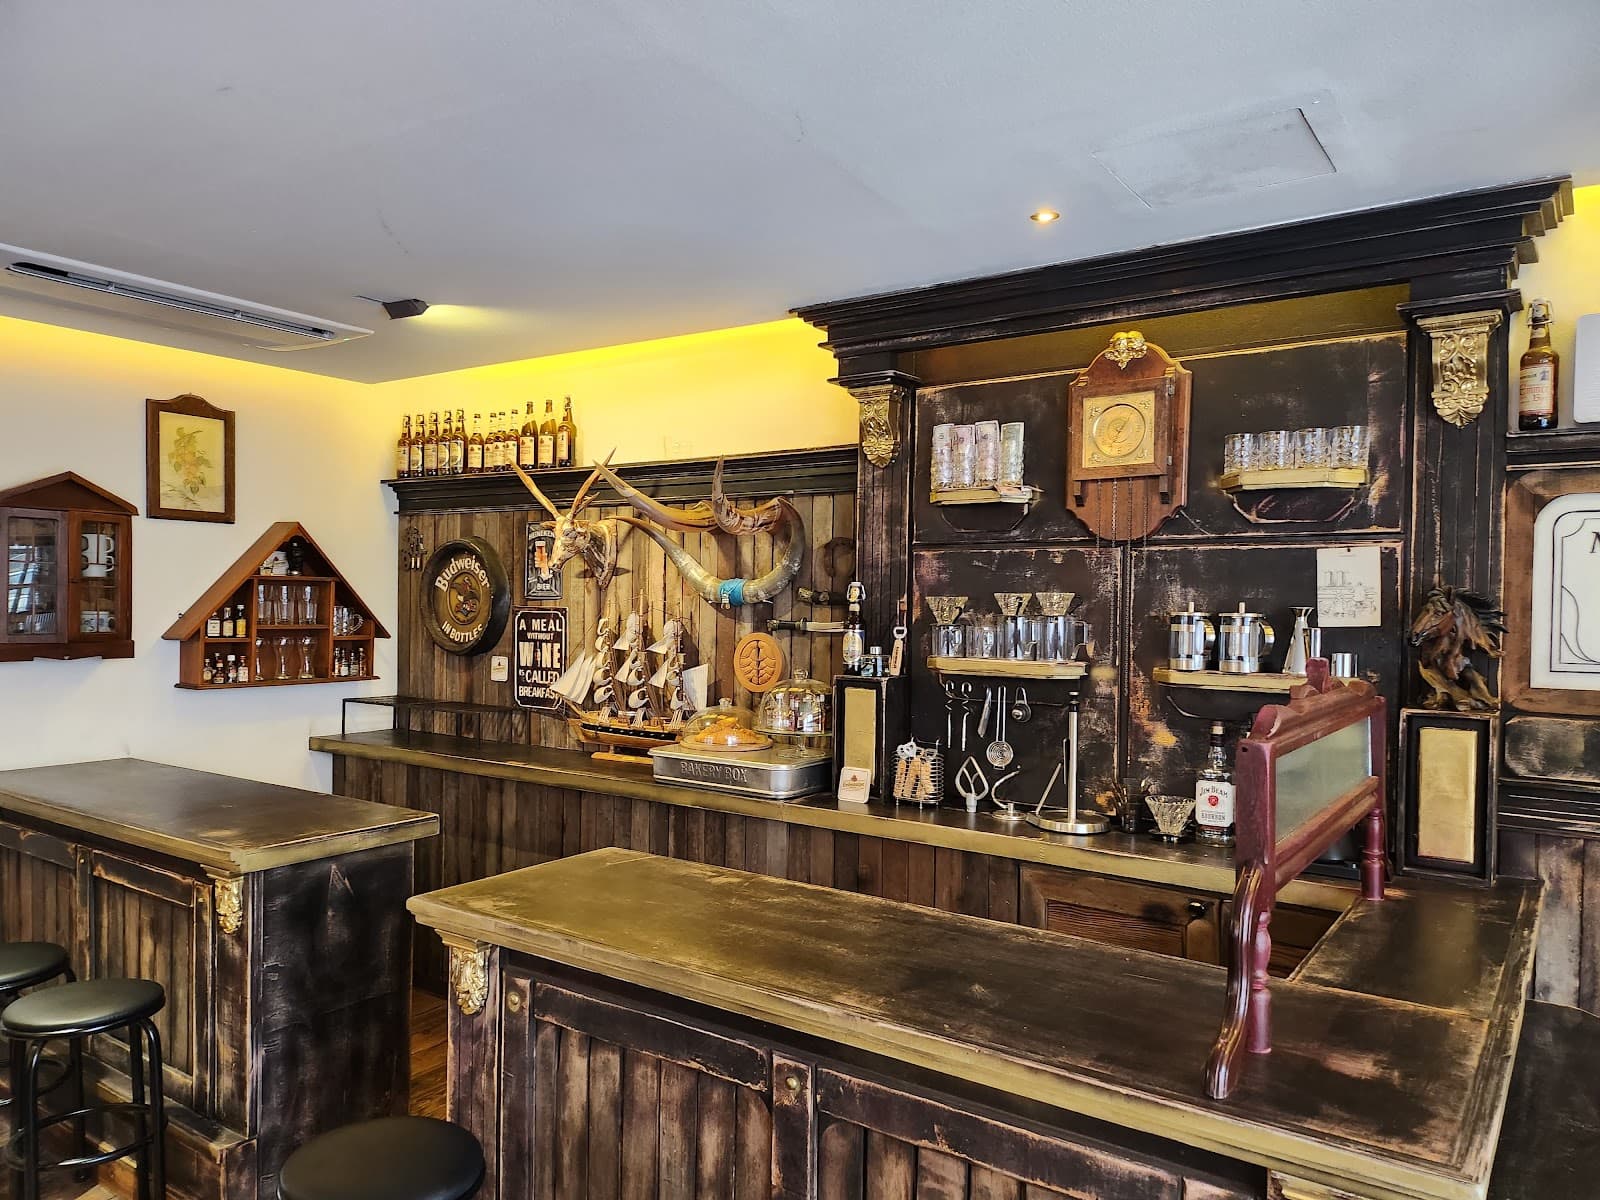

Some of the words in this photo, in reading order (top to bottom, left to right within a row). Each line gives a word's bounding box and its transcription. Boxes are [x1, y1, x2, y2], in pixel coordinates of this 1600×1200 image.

[435, 555, 490, 592] Budweiser
[536, 583, 551, 591] BIER
[441, 620, 452, 635] IN
[449, 623, 483, 642] BOTTLES
[519, 618, 527, 631] A
[531, 618, 562, 632] MEAL
[527, 632, 554, 640] WITHOUT
[519, 641, 561, 669] WINE
[525, 670, 560, 685] CALLED
[680, 761, 721, 778] BAKERY
[725, 766, 748, 783] BOX
[1211, 785, 1228, 798] BEAM
